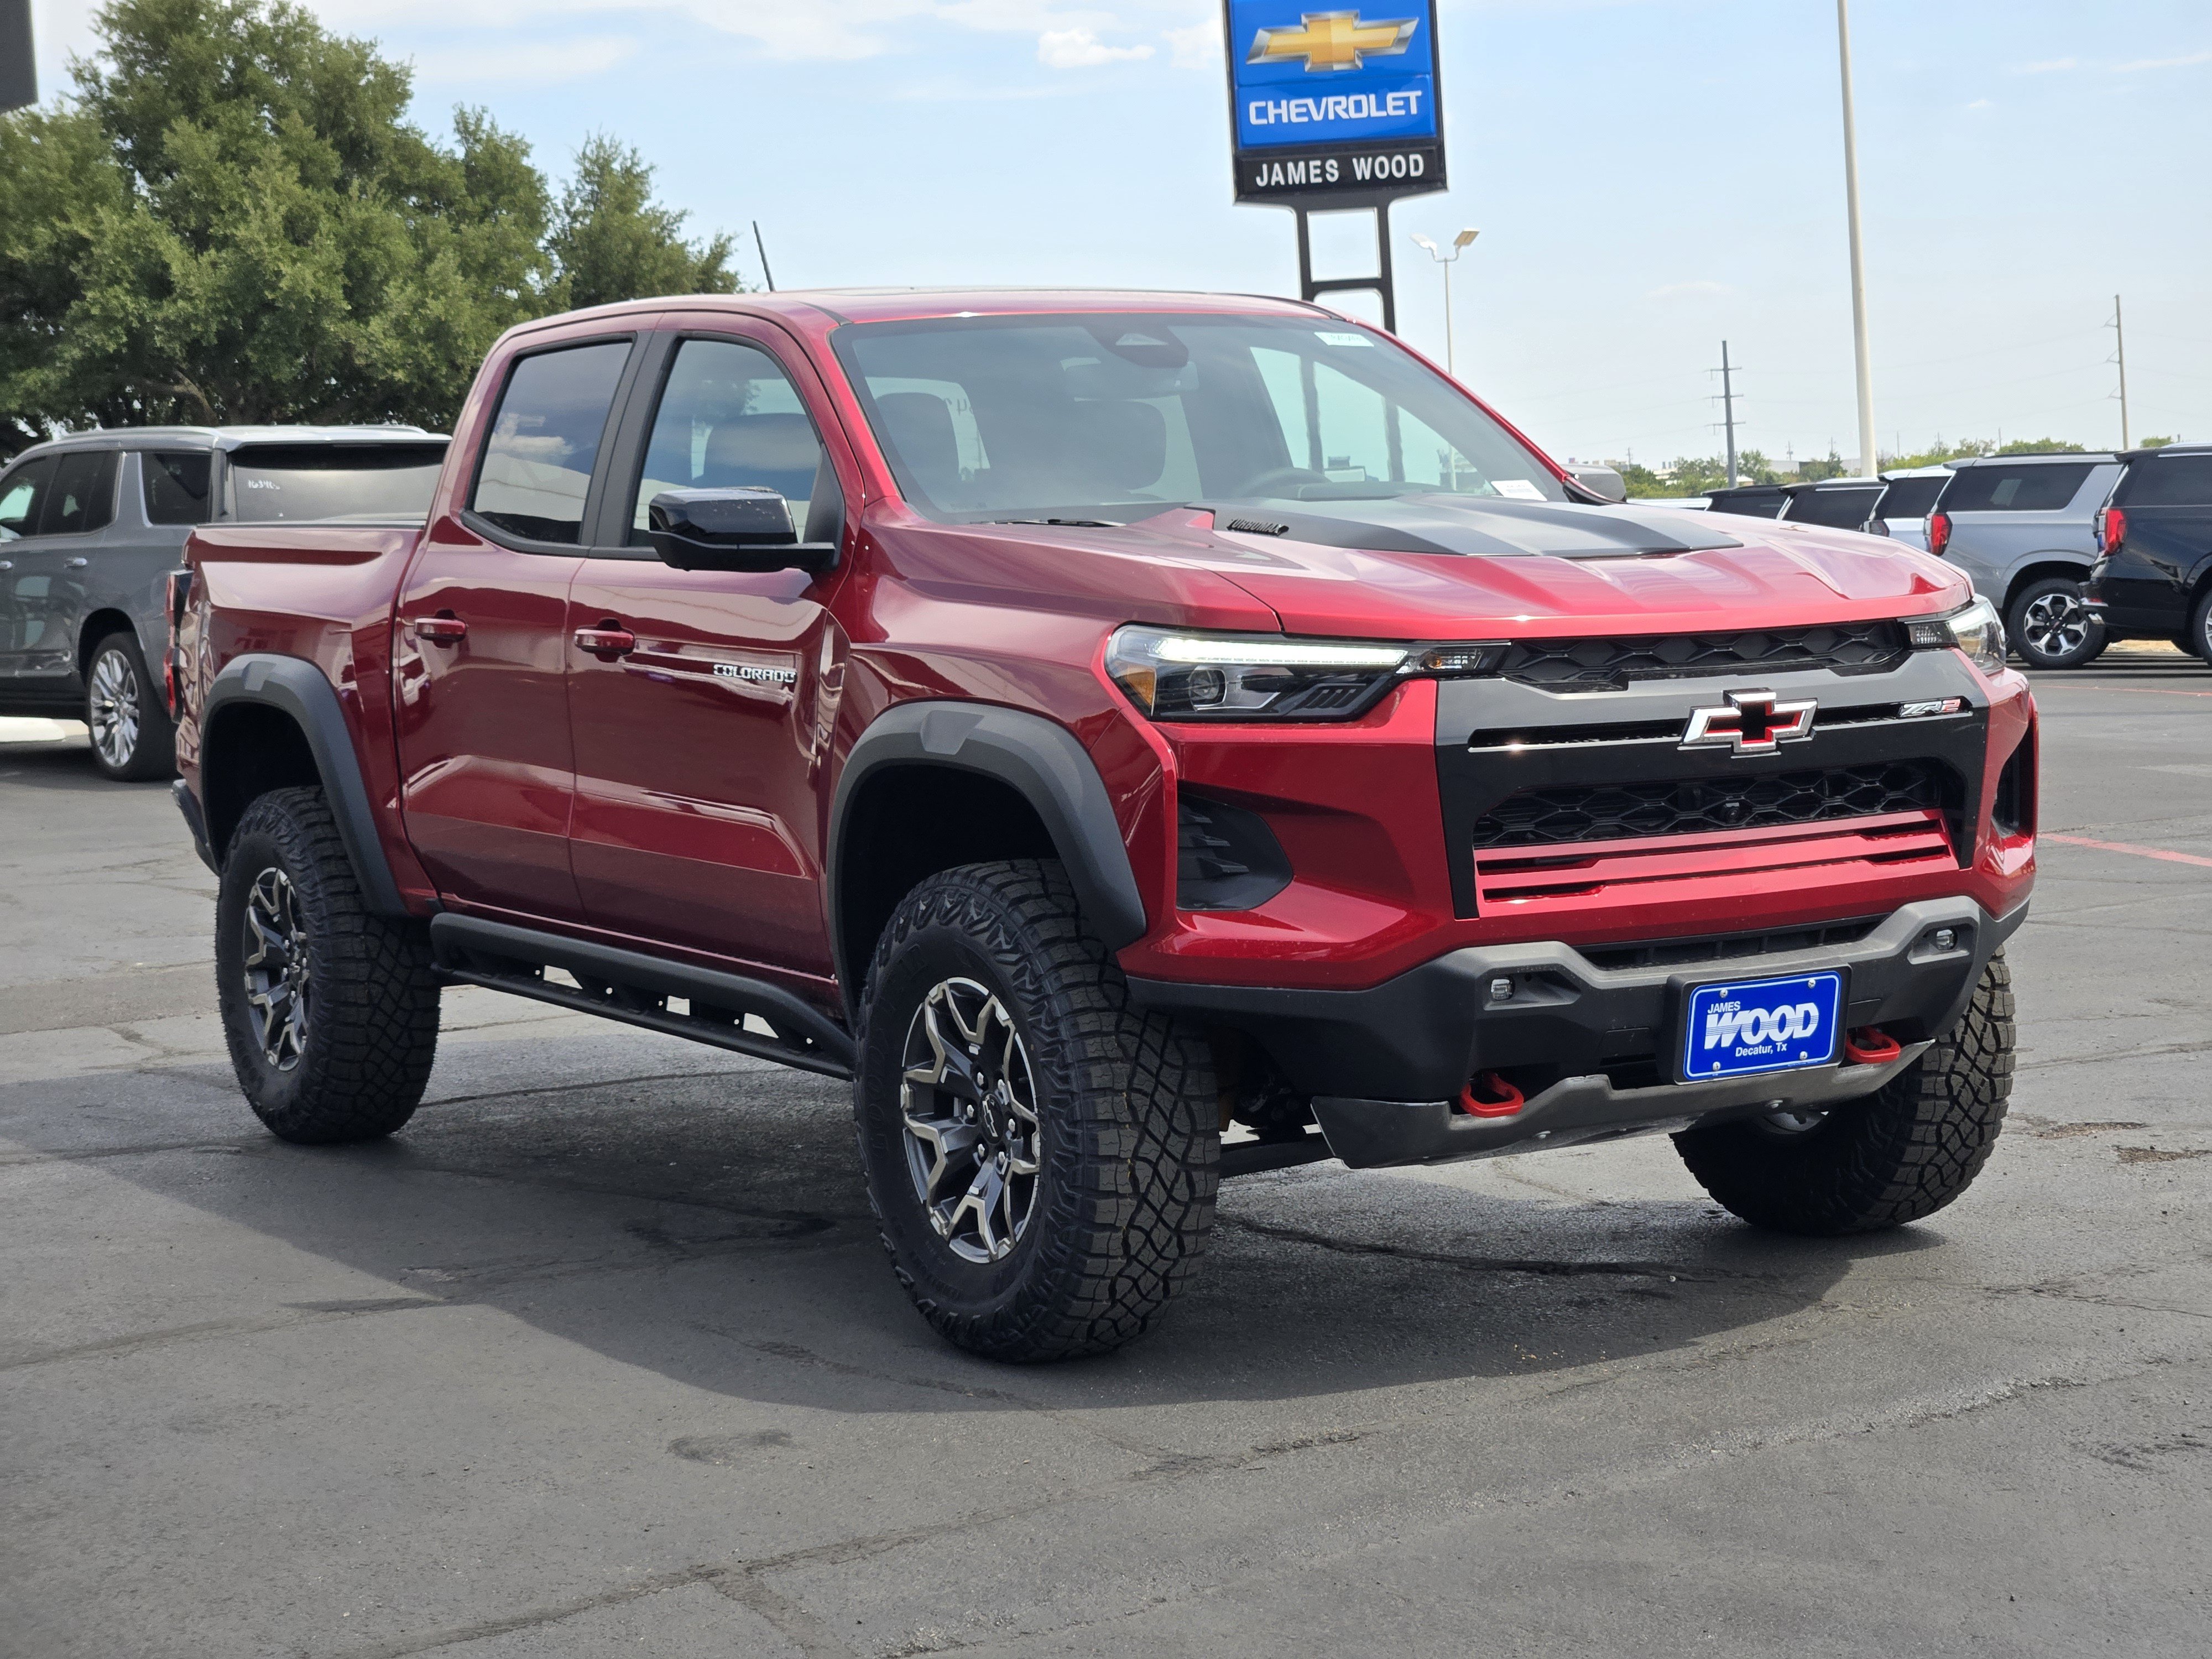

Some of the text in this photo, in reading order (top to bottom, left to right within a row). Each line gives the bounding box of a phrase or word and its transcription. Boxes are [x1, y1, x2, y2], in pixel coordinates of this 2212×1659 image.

[1249, 90, 1422, 125] CHEVROLET
[1256, 154, 1425, 187] JAMES WOOD
[713, 664, 796, 683] COLORADO
[1900, 698, 1961, 717] ZR2
[1707, 1001, 1741, 1014] JAMES
[1704, 1002, 1819, 1050] WOOD
[1735, 1042, 1787, 1057] Decatur, Tx
